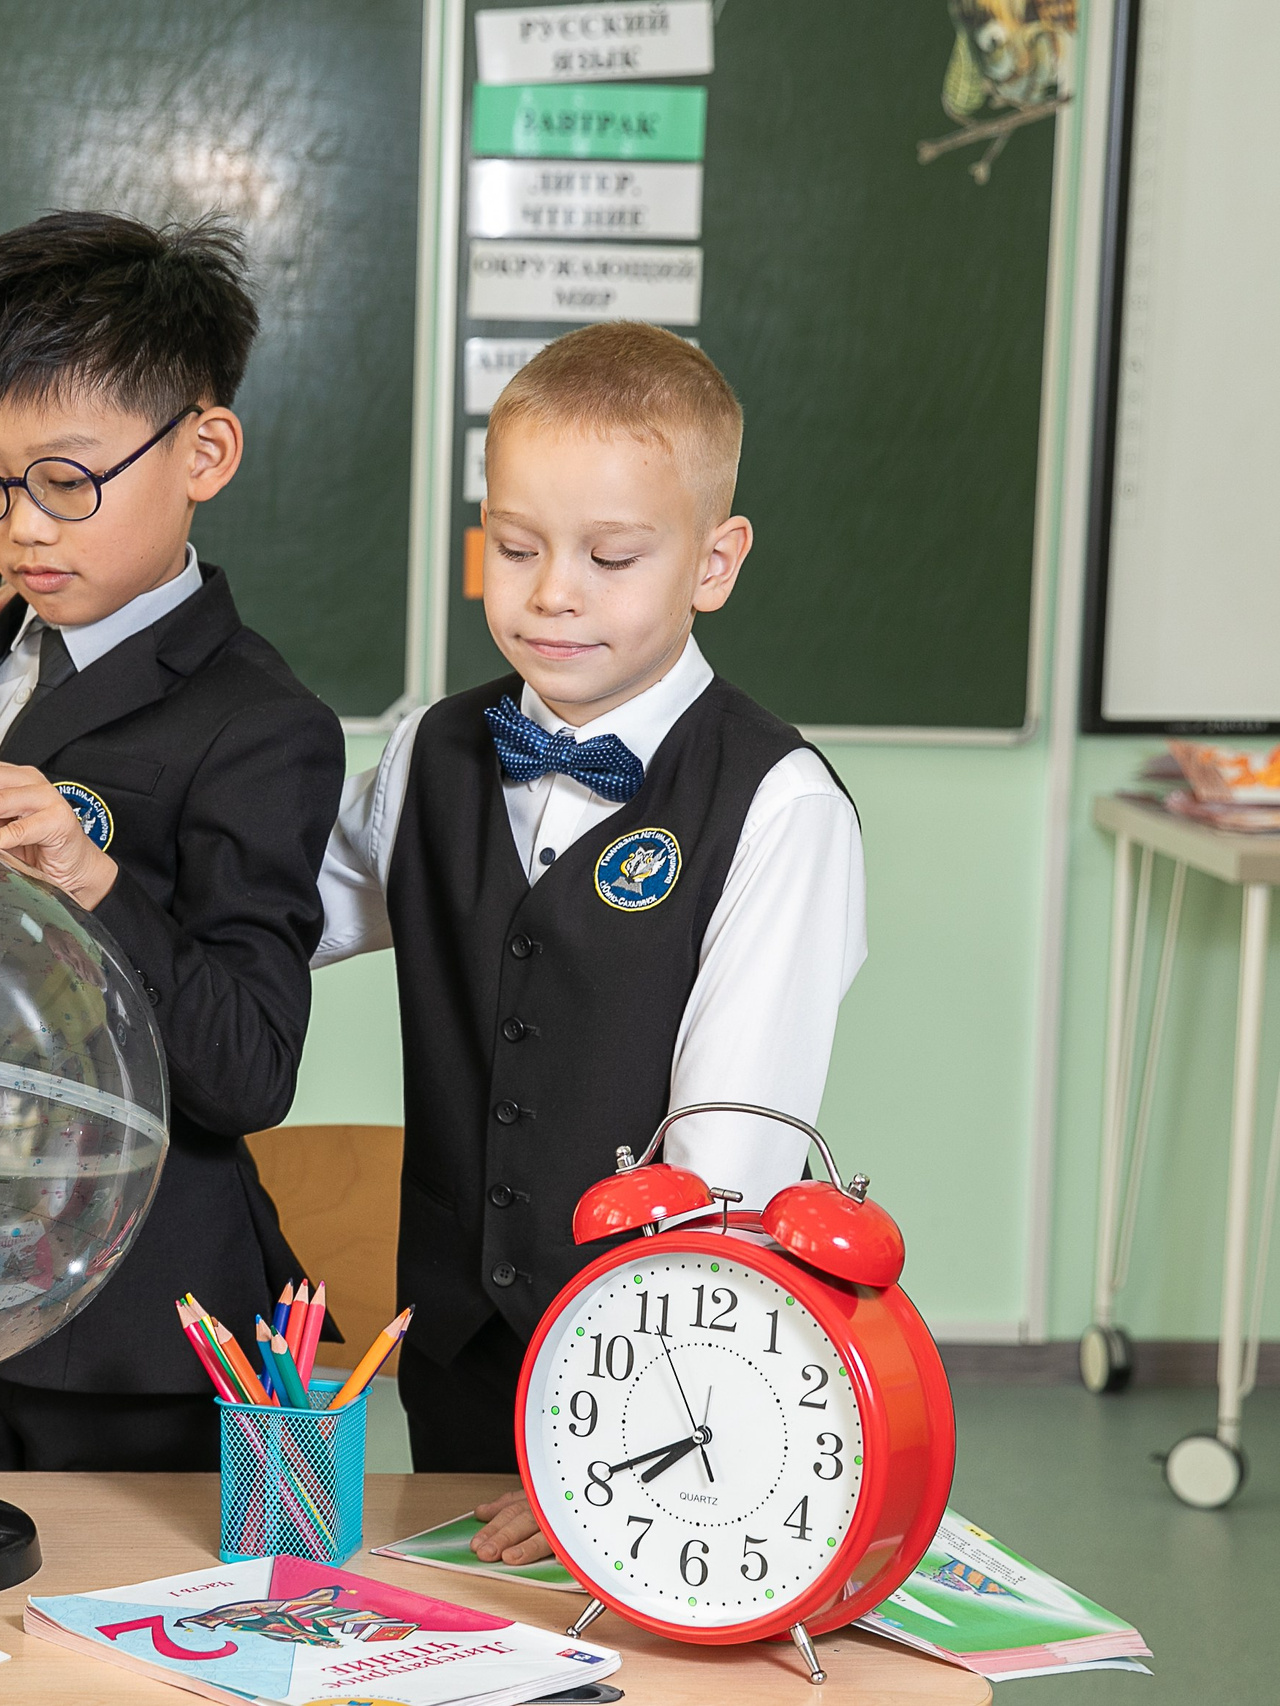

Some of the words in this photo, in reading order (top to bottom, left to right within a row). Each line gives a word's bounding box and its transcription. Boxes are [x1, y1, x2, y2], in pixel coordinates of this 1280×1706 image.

[633, 1291, 672, 1337] 11
[689, 1284, 738, 1332] 12
[763, 1310, 782, 1354] 1
[587, 1333, 634, 1381] 10
[799, 1364, 828, 1409] 2
[569, 1391, 598, 1437] 9
[813, 1432, 843, 1480] 3
[584, 1461, 613, 1506] 8
[679, 1492, 718, 1506] QUARTZ
[627, 1515, 653, 1559] 7
[783, 1495, 812, 1541] 4
[680, 1540, 709, 1586] 6
[740, 1535, 768, 1581] 5
[180, 1581, 236, 1594] Часть
[95, 1614, 239, 1661] 2
[321, 1641, 463, 1677] ЧТЕНИЕ
[322, 1640, 518, 1690] Литературное
